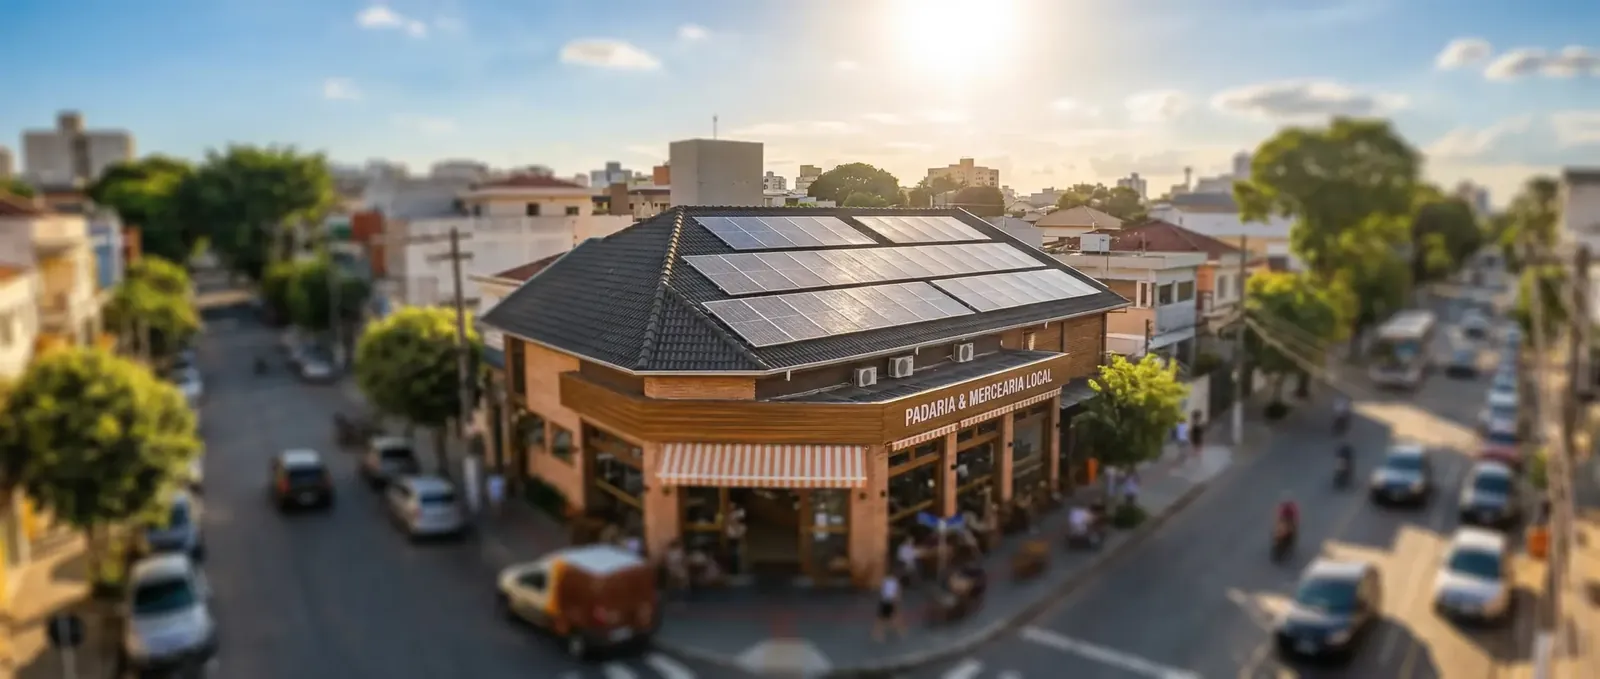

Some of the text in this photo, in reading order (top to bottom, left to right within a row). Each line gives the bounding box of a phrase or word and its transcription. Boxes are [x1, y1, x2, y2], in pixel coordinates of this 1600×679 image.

[905, 368, 1053, 427] PADARIA & MERCEARIA LOCAL
